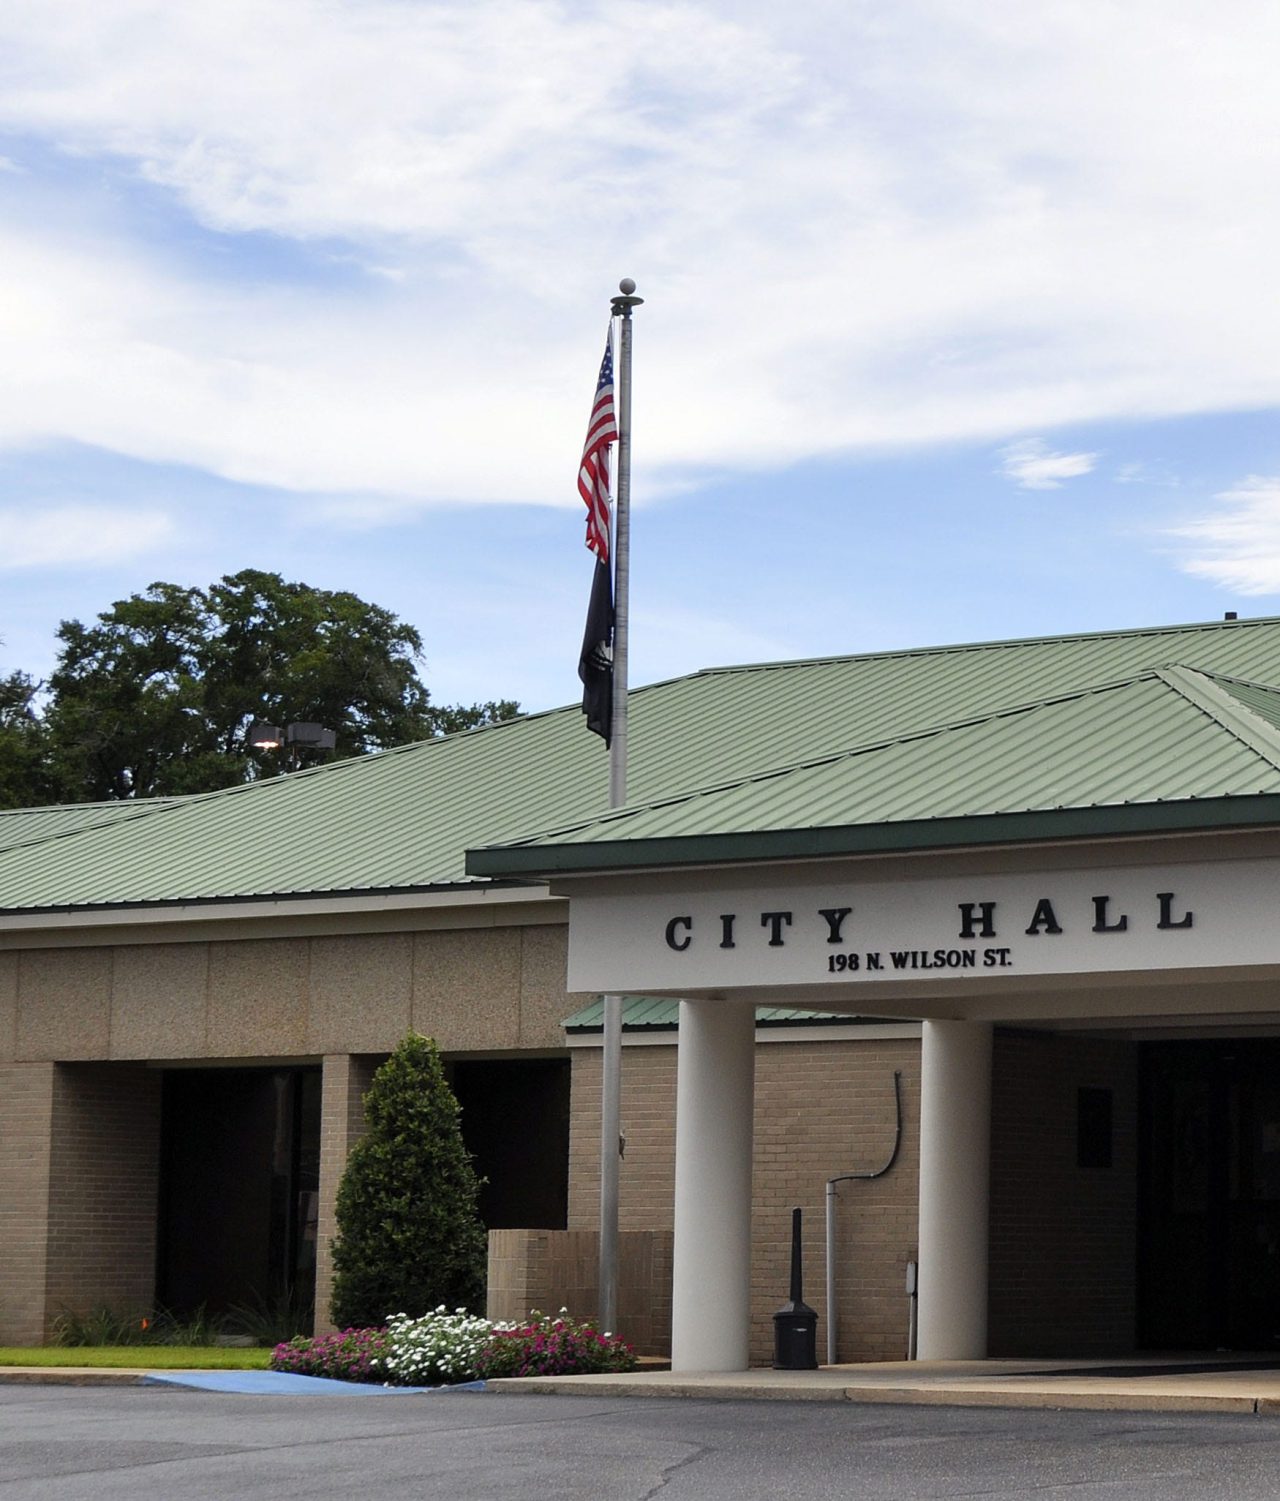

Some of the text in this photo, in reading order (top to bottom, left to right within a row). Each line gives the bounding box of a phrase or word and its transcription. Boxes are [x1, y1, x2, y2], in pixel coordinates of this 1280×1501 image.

[665, 892, 1194, 952] CITY HALL
[828, 947, 1013, 972] 198 N. WILSON ST.
